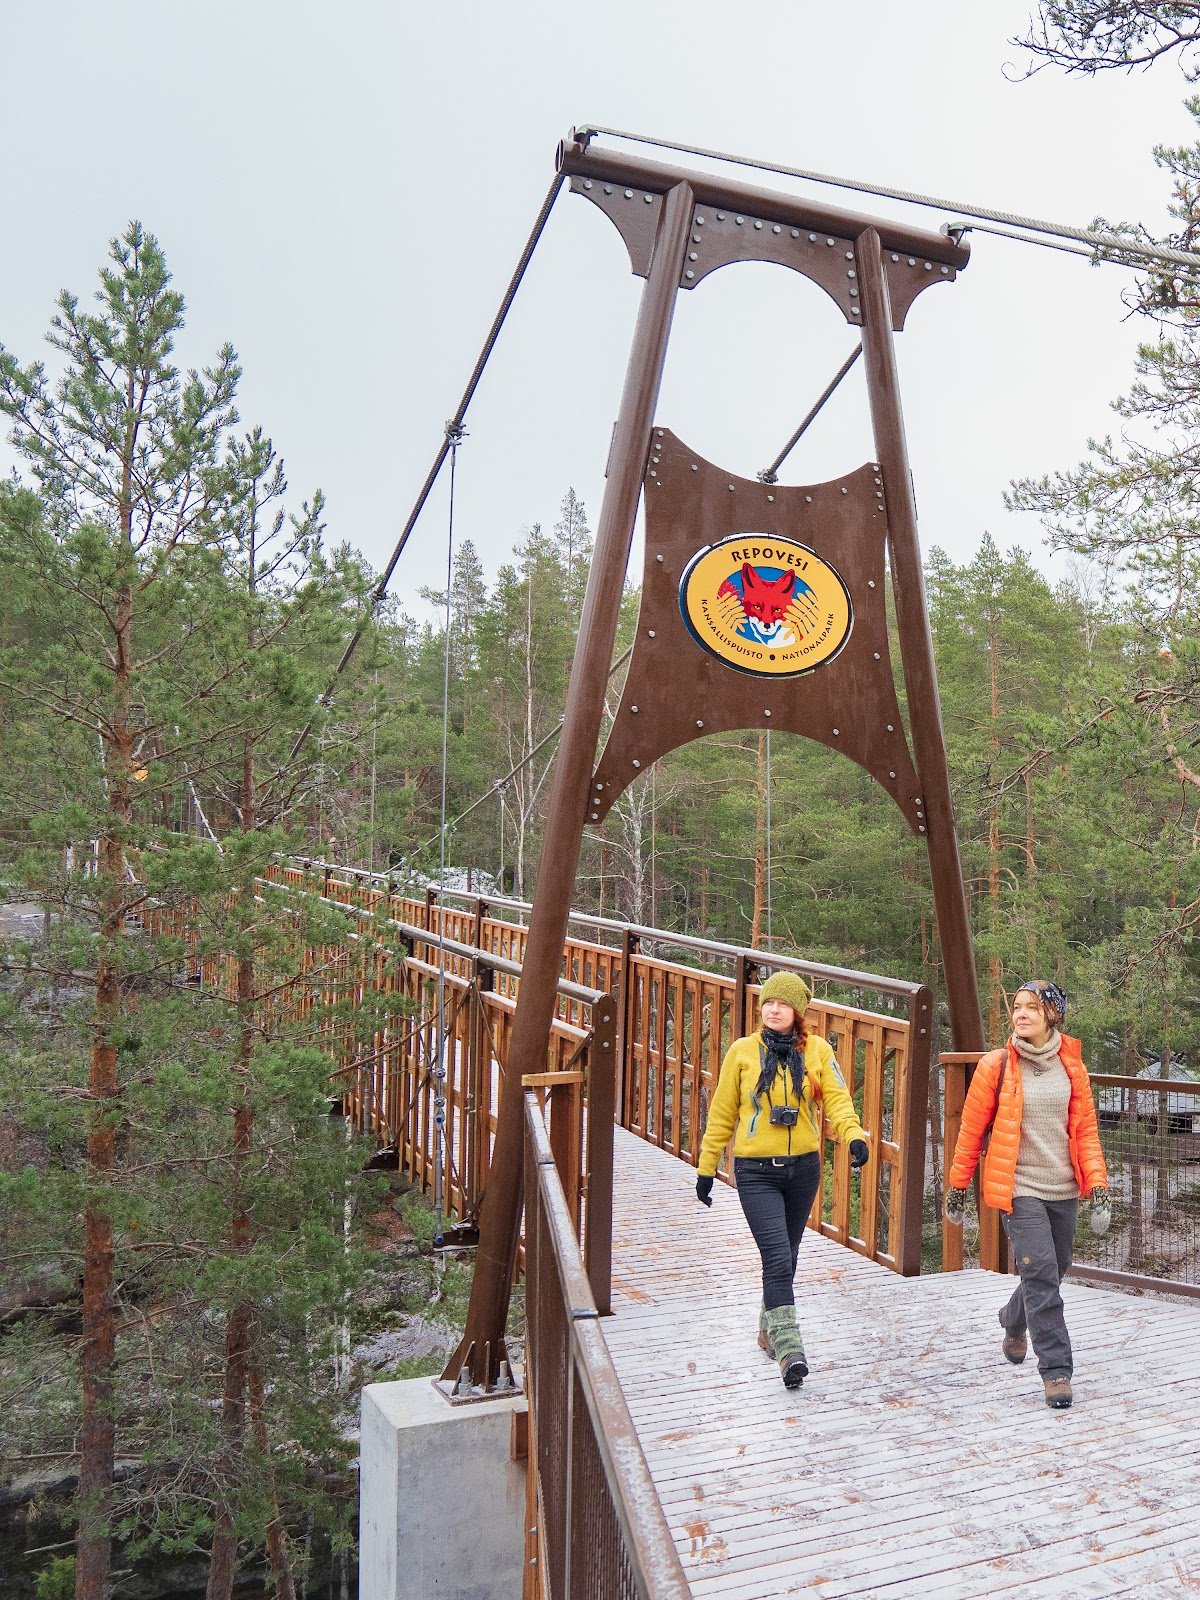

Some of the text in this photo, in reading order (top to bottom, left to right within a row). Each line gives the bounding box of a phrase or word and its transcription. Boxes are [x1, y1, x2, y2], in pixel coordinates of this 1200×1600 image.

[731, 547, 808, 571] REPOVESI
[701, 599, 763, 660] KANSALLISPUISTO
[782, 613, 834, 660] NATIONALPARK
